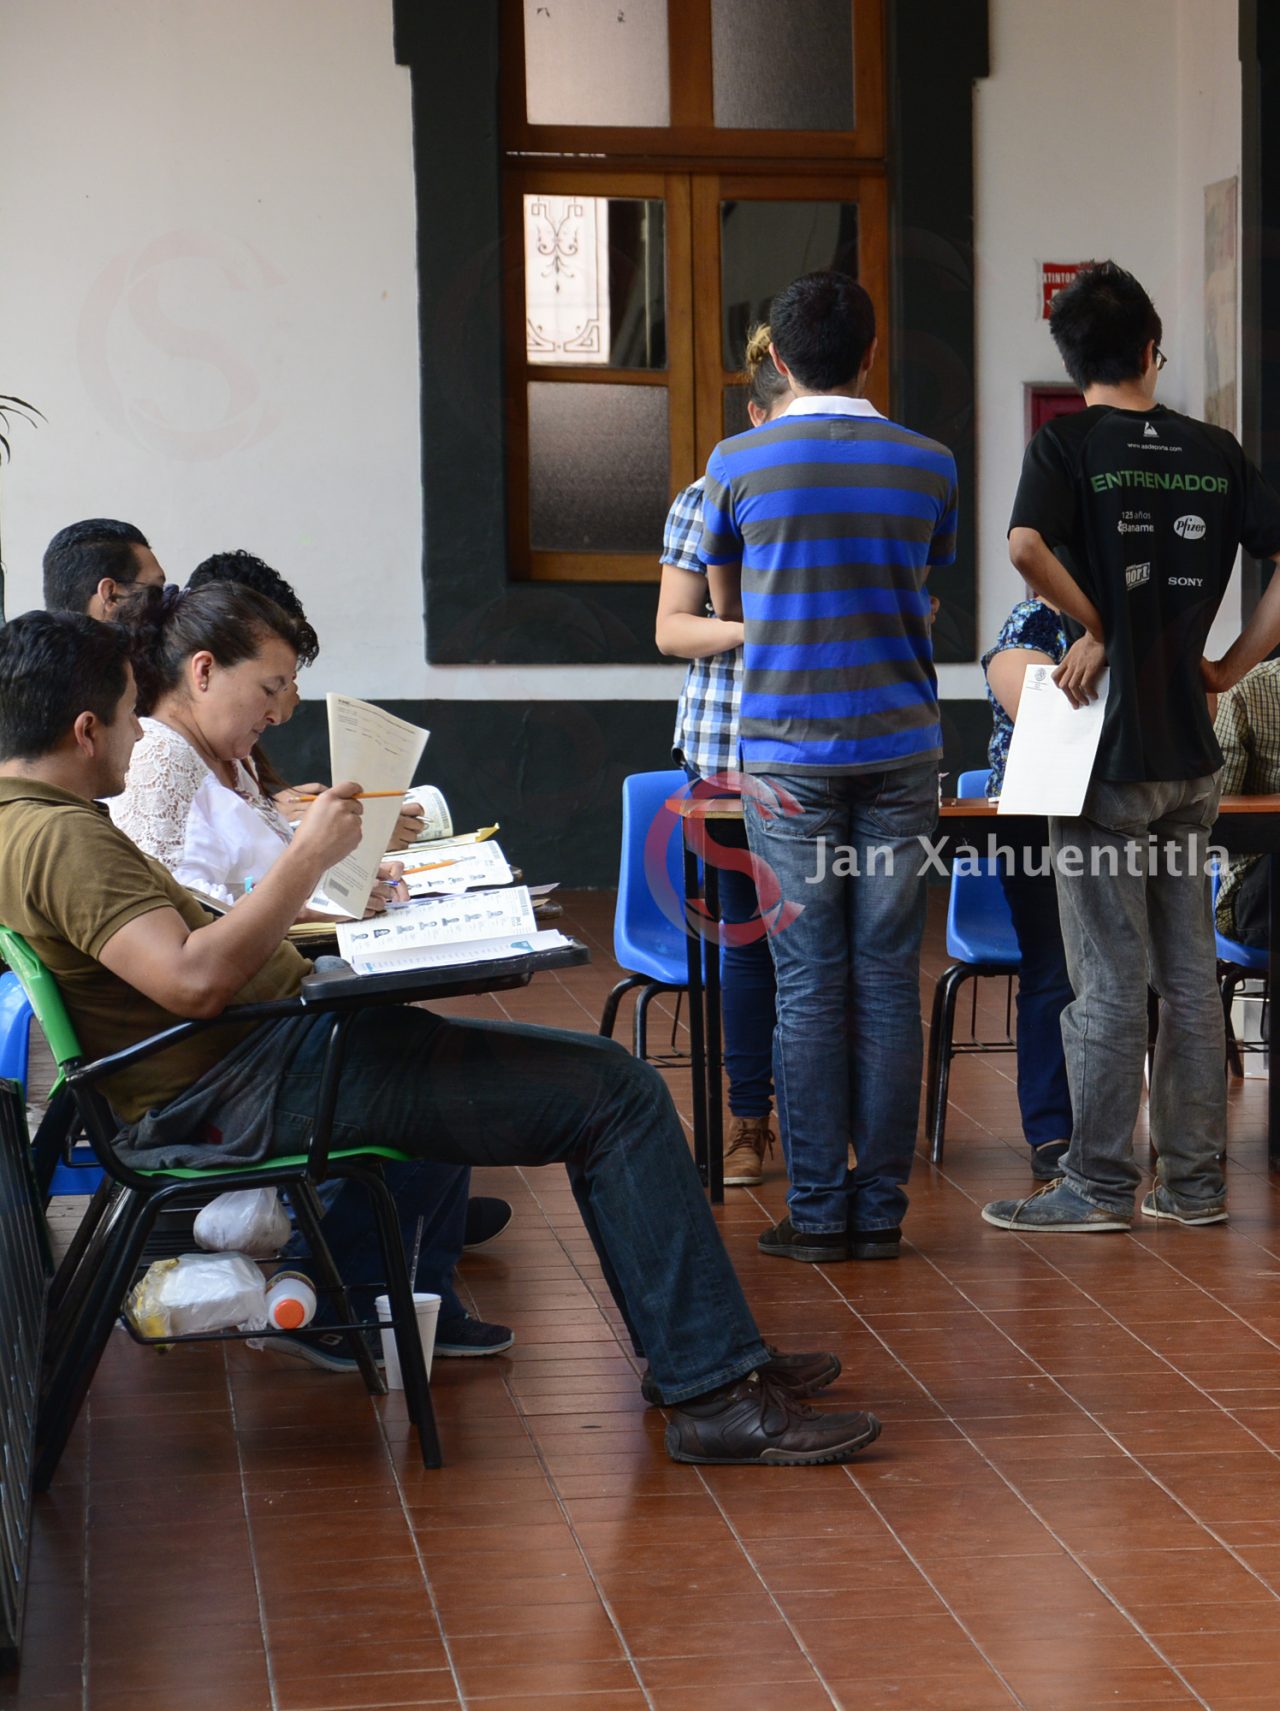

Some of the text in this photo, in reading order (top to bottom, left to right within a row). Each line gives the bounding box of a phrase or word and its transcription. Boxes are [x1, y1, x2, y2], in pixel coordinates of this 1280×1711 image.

[1090, 470, 1229, 494] ENTRENADOR
[1176, 518, 1206, 538] Pfizer
[1168, 577, 1203, 586] SONY
